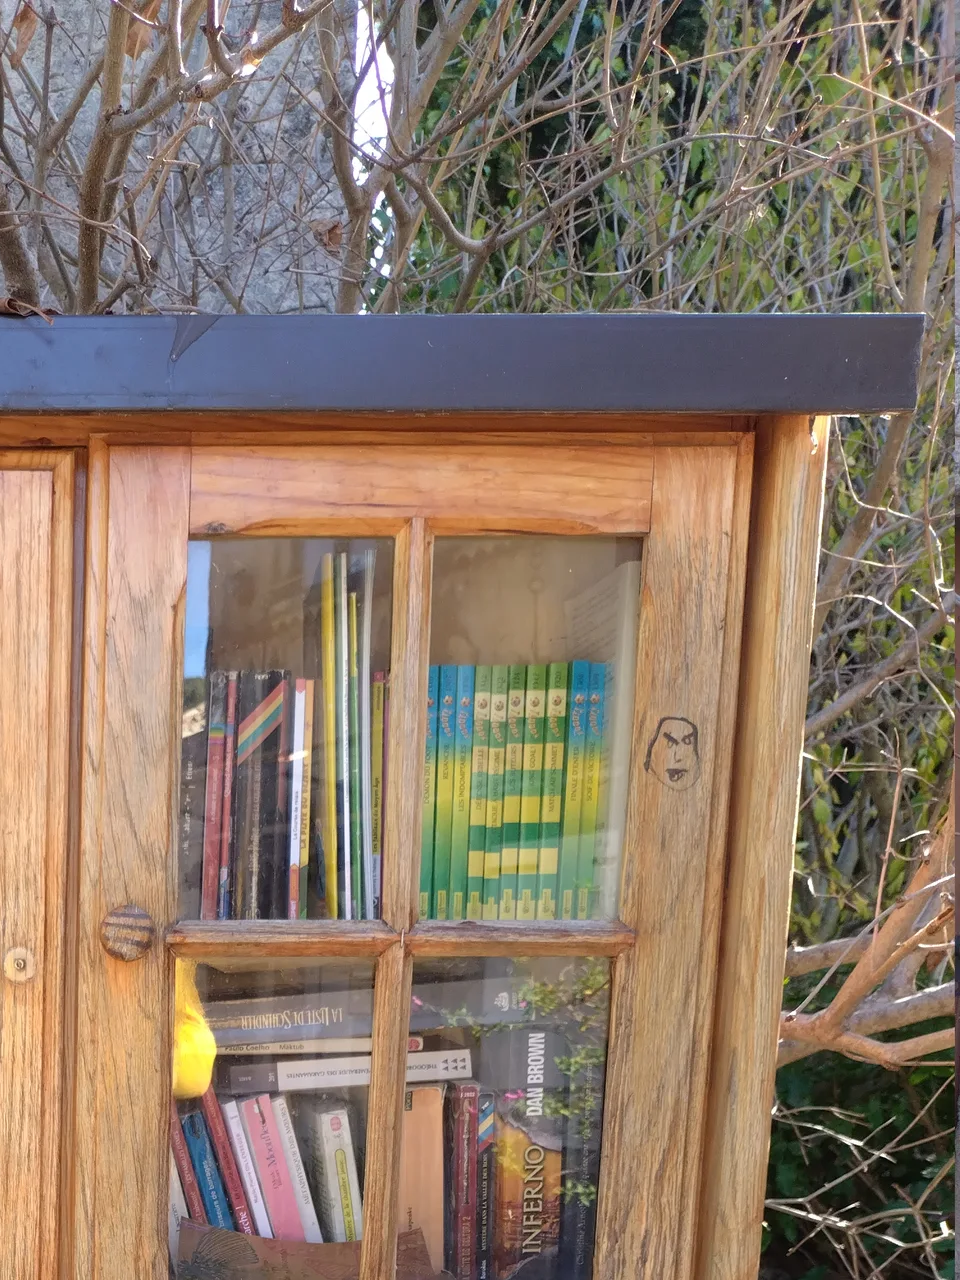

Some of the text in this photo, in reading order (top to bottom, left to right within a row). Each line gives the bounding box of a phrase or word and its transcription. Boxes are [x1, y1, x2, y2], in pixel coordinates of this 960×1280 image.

[587, 741, 595, 774] VICTOIRE
[424, 765, 431, 777] DU
[459, 744, 467, 798] INDOMPTABLES
[570, 746, 580, 802] FINALE D'ENFER
[587, 774, 594, 784] DE
[373, 790, 381, 808] Moyen
[241, 1006, 343, 1031] LA LISTE DE SCHINDLER
[245, 1043, 270, 1051] Coelho
[278, 1043, 304, 1051] Maktub
[526, 1032, 545, 1084] BROWN
[286, 1071, 326, 1079] GARAMANTES
[525, 1087, 544, 1117] DAN
[287, 1135, 296, 1149] DES
[291, 1150, 310, 1205] MÉTAPHYSIQUE
[341, 1177, 350, 1201] chambre
[202, 1160, 226, 1228] briseurs de barrages
[482, 1201, 488, 1209] LA
[521, 1144, 545, 1254] INFERNO
[238, 1211, 253, 1236] arche
[345, 1210, 352, 1218] de
